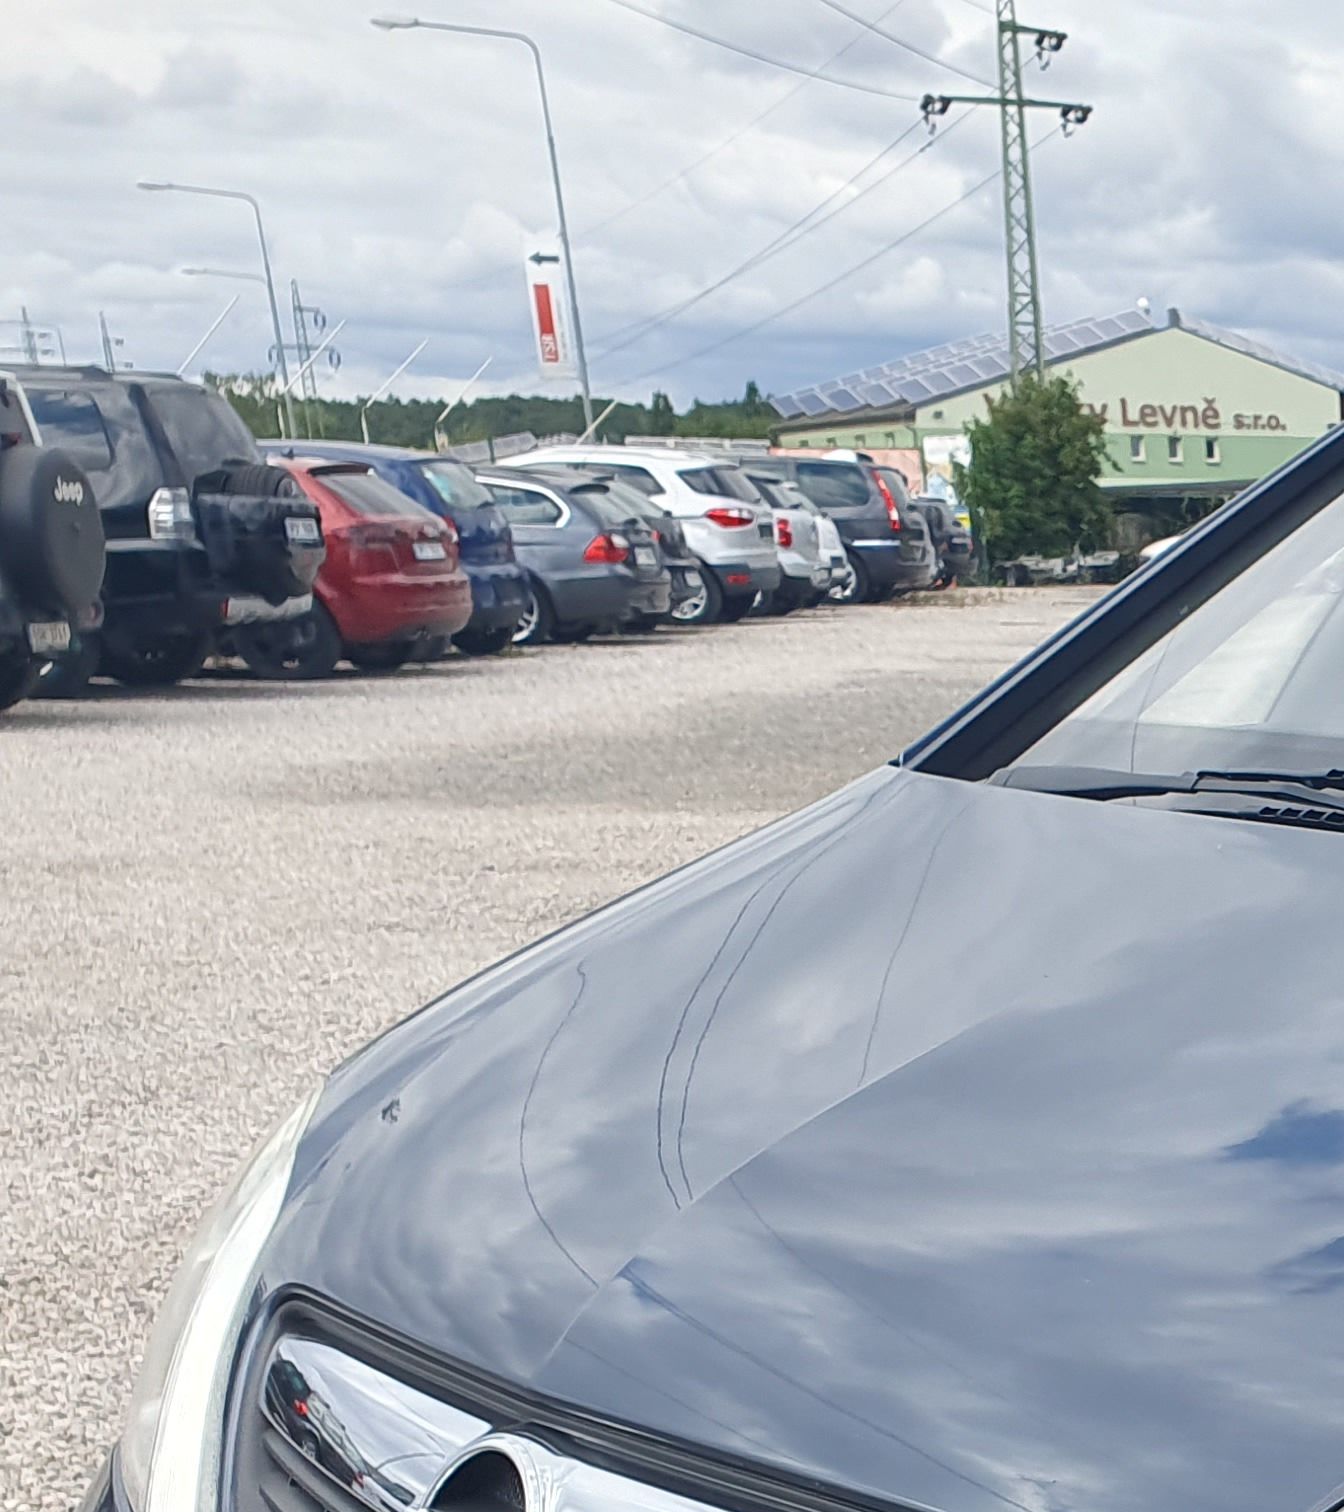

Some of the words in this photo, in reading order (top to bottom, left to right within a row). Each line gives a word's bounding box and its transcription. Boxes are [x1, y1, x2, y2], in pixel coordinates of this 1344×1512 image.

[1121, 397, 1221, 430] Levně
[1233, 413, 1287, 431] s.r.o.
[54, 475, 84, 506] Jeep
